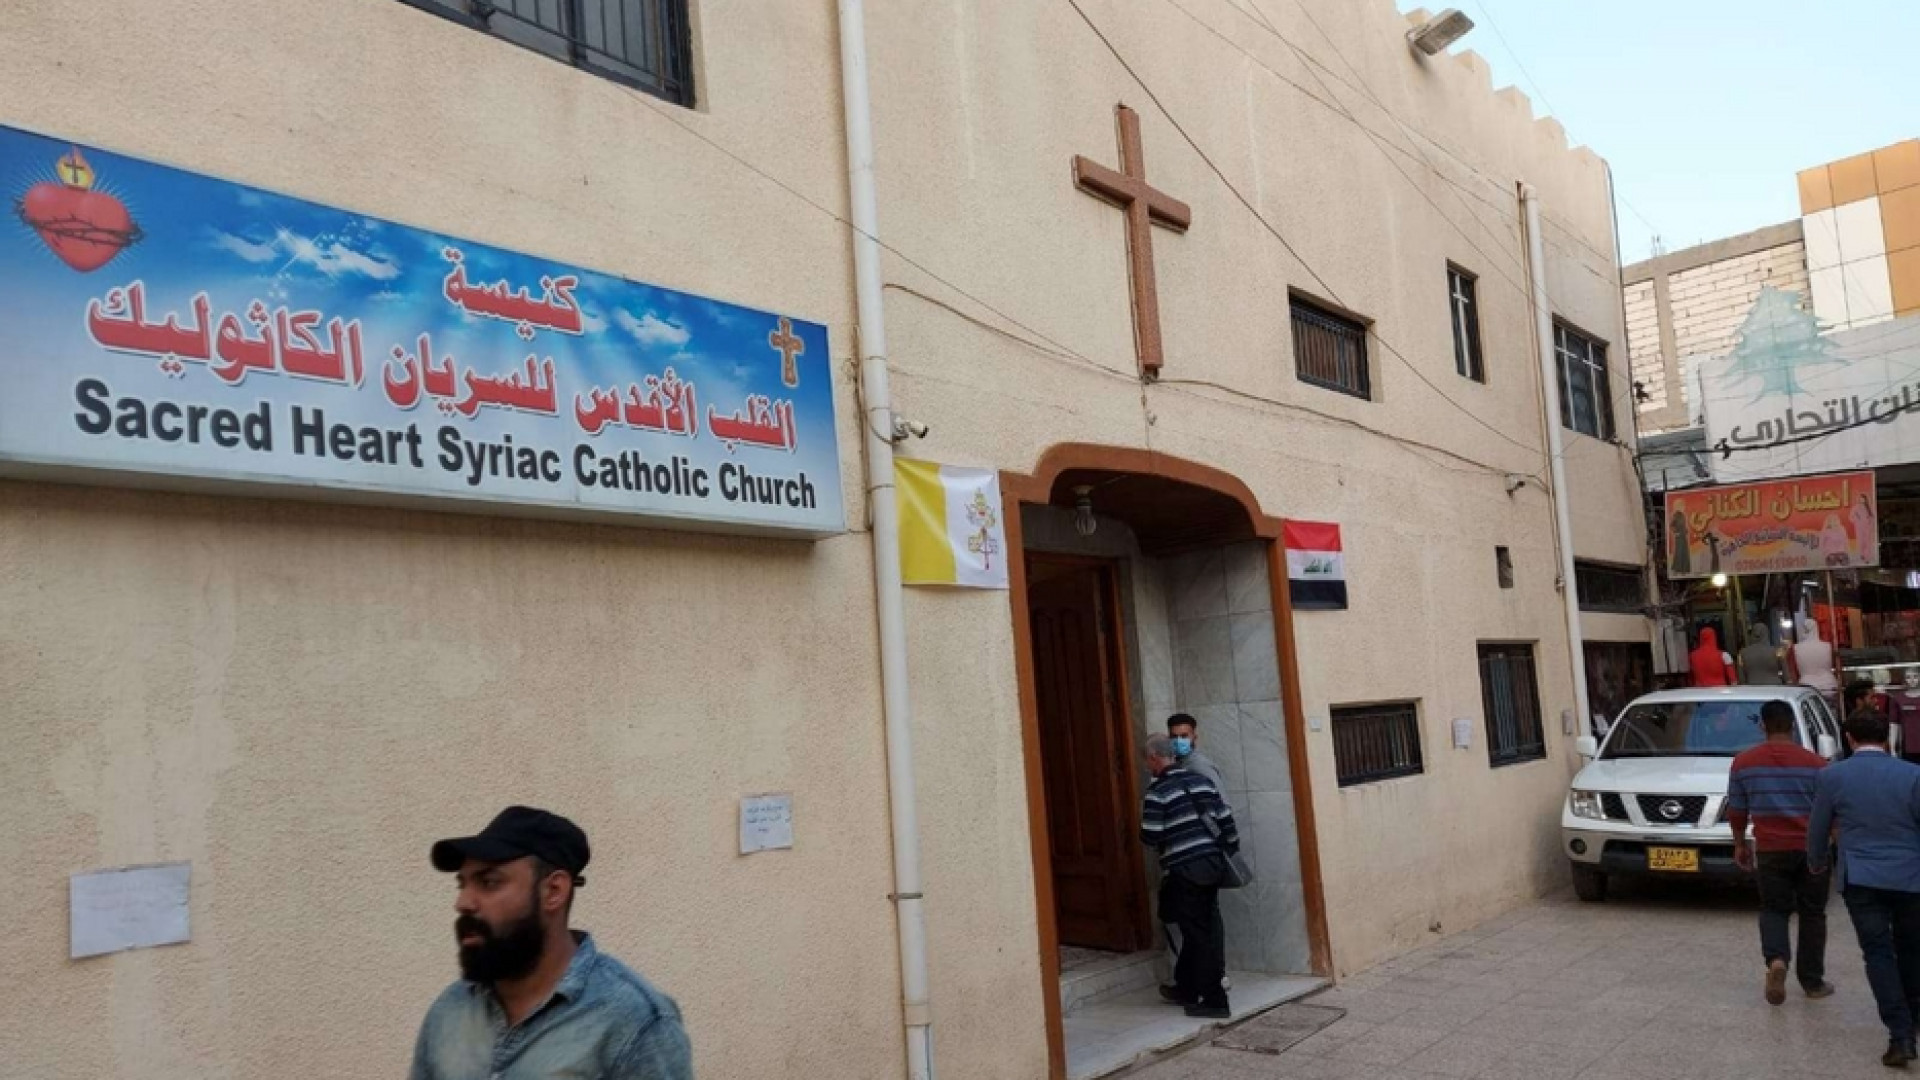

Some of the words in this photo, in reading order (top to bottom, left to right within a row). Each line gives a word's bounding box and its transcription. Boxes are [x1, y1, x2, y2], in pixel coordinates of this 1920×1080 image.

[88, 281, 363, 386] الكاثوليك
[442, 248, 583, 337] كنيسة
[385, 334, 557, 416] للسريان
[575, 367, 697, 435] الأقدس
[74, 378, 273, 451] Sacred
[291, 404, 424, 468] Heart
[437, 425, 561, 486] Syriac
[574, 444, 710, 498] Catholic
[719, 462, 816, 508] Church
[708, 394, 796, 452] القلب
